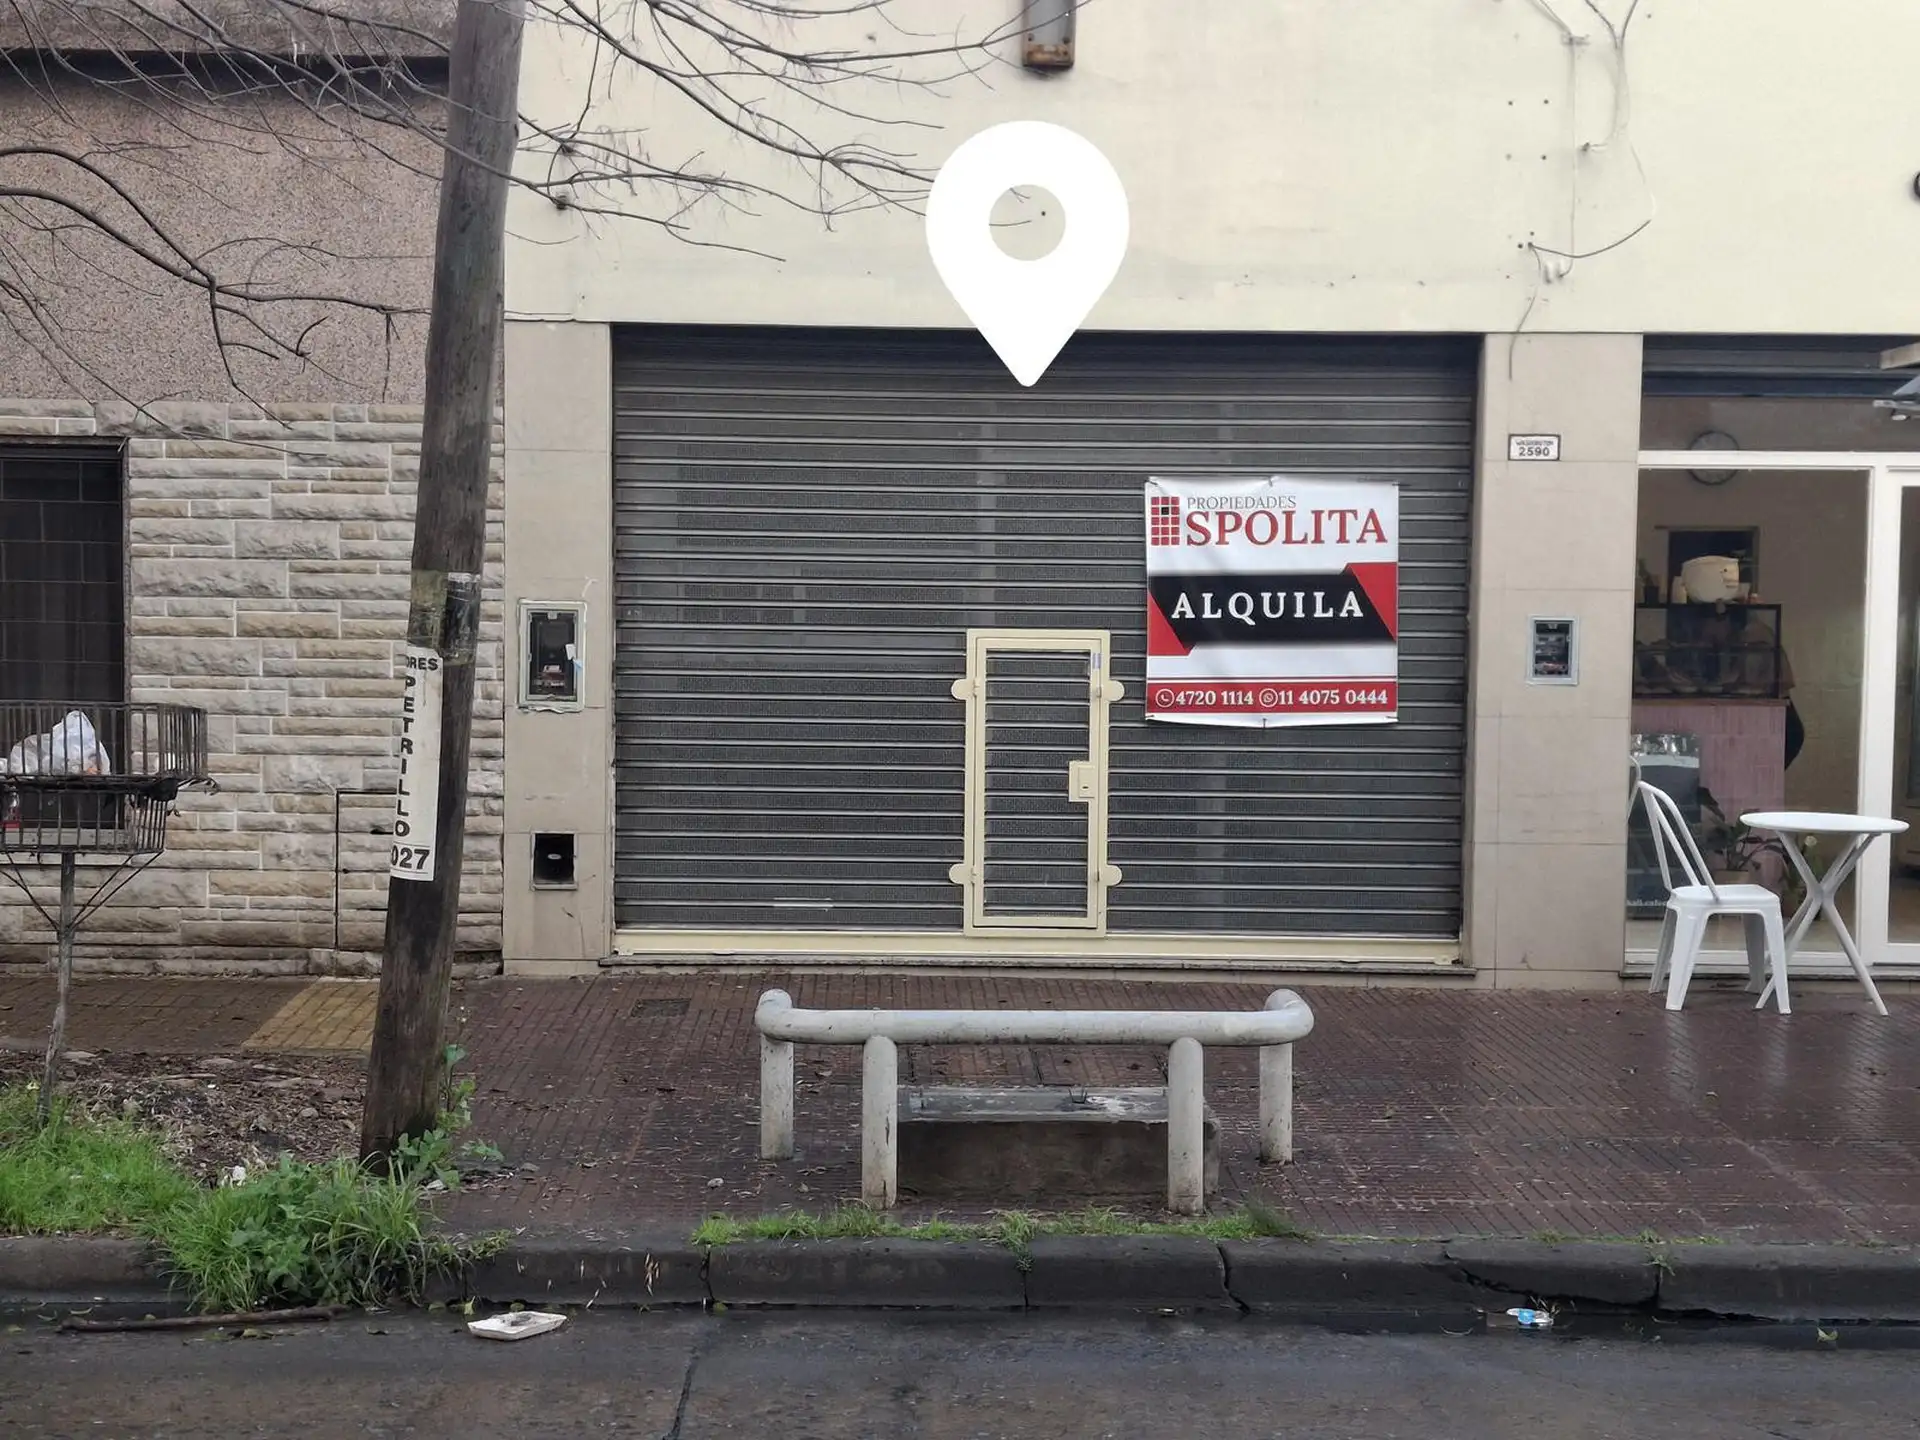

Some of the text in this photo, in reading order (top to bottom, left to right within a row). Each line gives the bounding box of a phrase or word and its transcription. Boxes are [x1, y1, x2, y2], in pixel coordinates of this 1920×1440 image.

[1519, 447, 1550, 457] 2590
[1187, 496, 1297, 510] PROPIEDADES
[1186, 508, 1388, 546] SPOLITA
[1171, 591, 1363, 626] ALQUILA
[1176, 689, 1388, 705] 4720 1114 11 4075 0444
